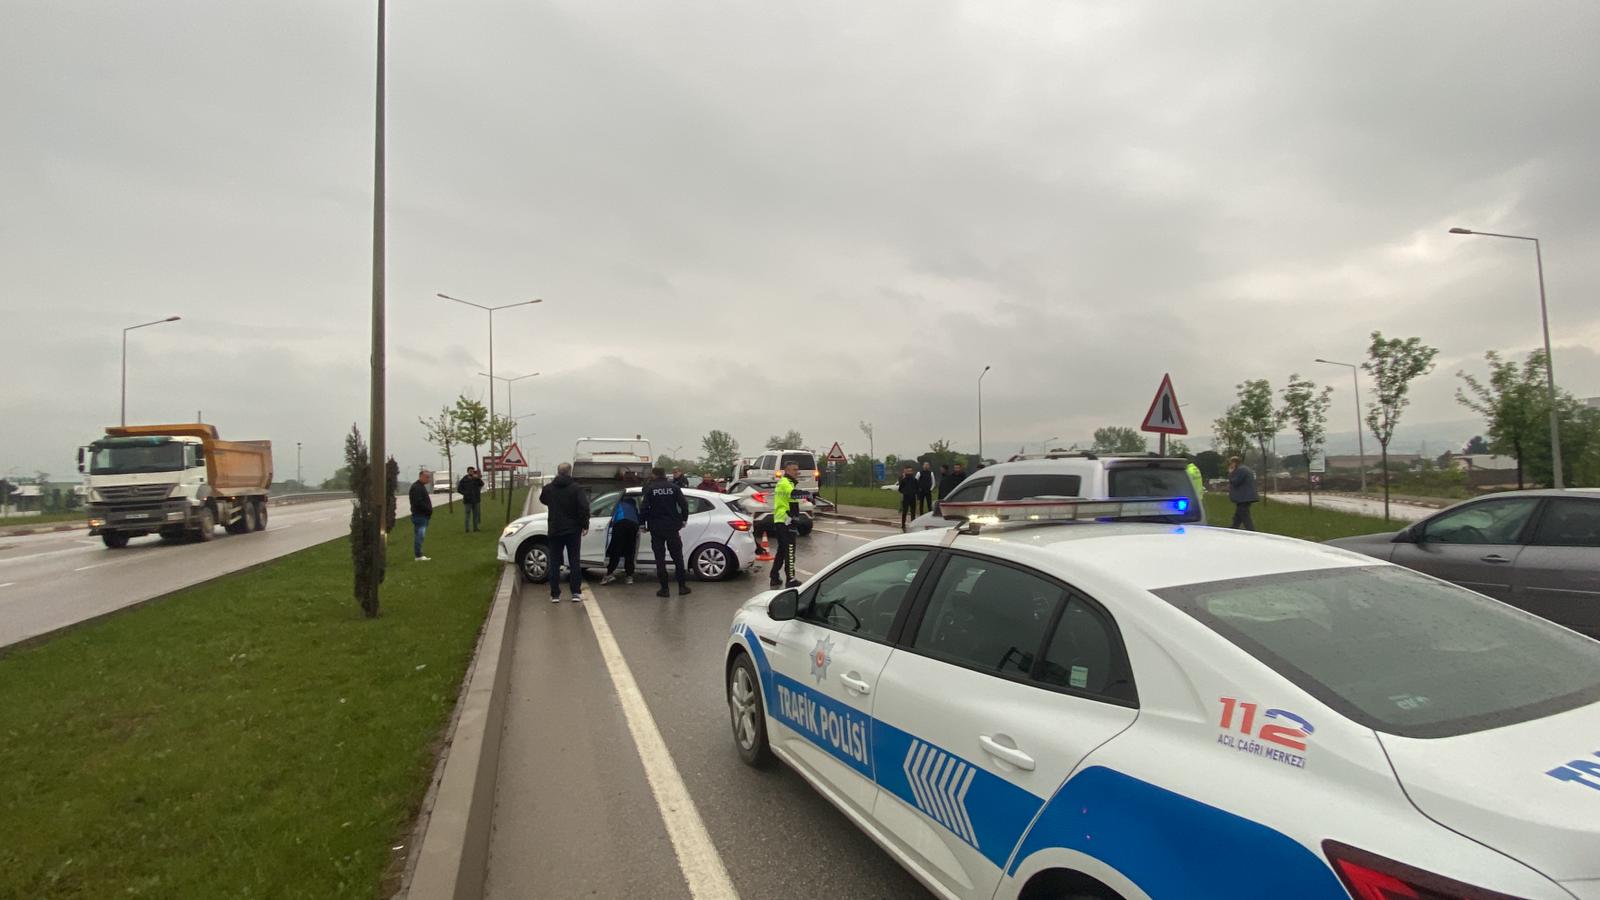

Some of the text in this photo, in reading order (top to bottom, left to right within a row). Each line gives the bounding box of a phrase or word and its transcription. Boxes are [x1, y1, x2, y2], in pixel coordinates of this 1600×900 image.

[778, 685, 868, 765] TRAFİK POLİSİ
[1219, 697, 1314, 751] 112
